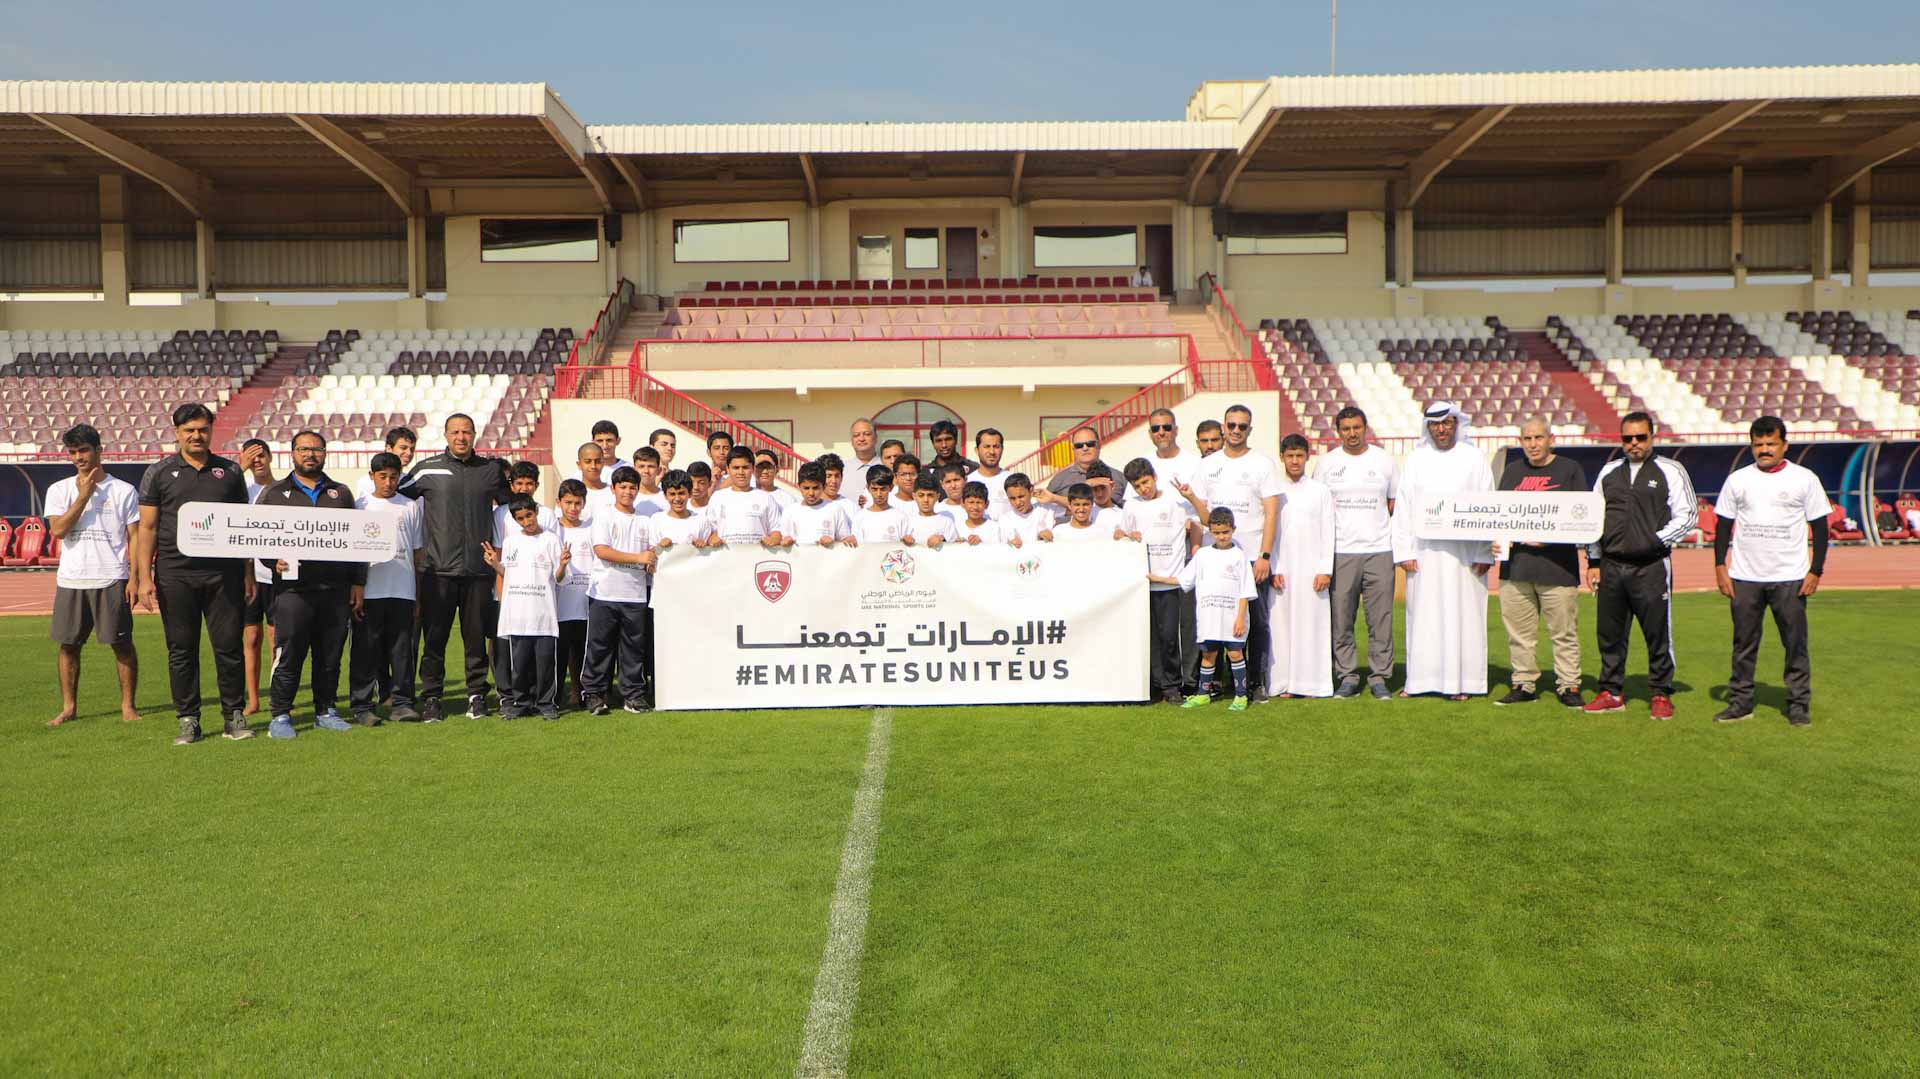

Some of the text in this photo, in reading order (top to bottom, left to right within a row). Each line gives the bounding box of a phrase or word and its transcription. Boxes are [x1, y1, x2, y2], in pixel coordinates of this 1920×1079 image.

[1514, 476, 1552, 491] NIKE
[1453, 518, 1557, 531] #EmiratesUniteUs
[228, 534, 349, 549] #EmiratesUniteUs
[736, 659, 1070, 686] #EMIRATESUNITEUS
